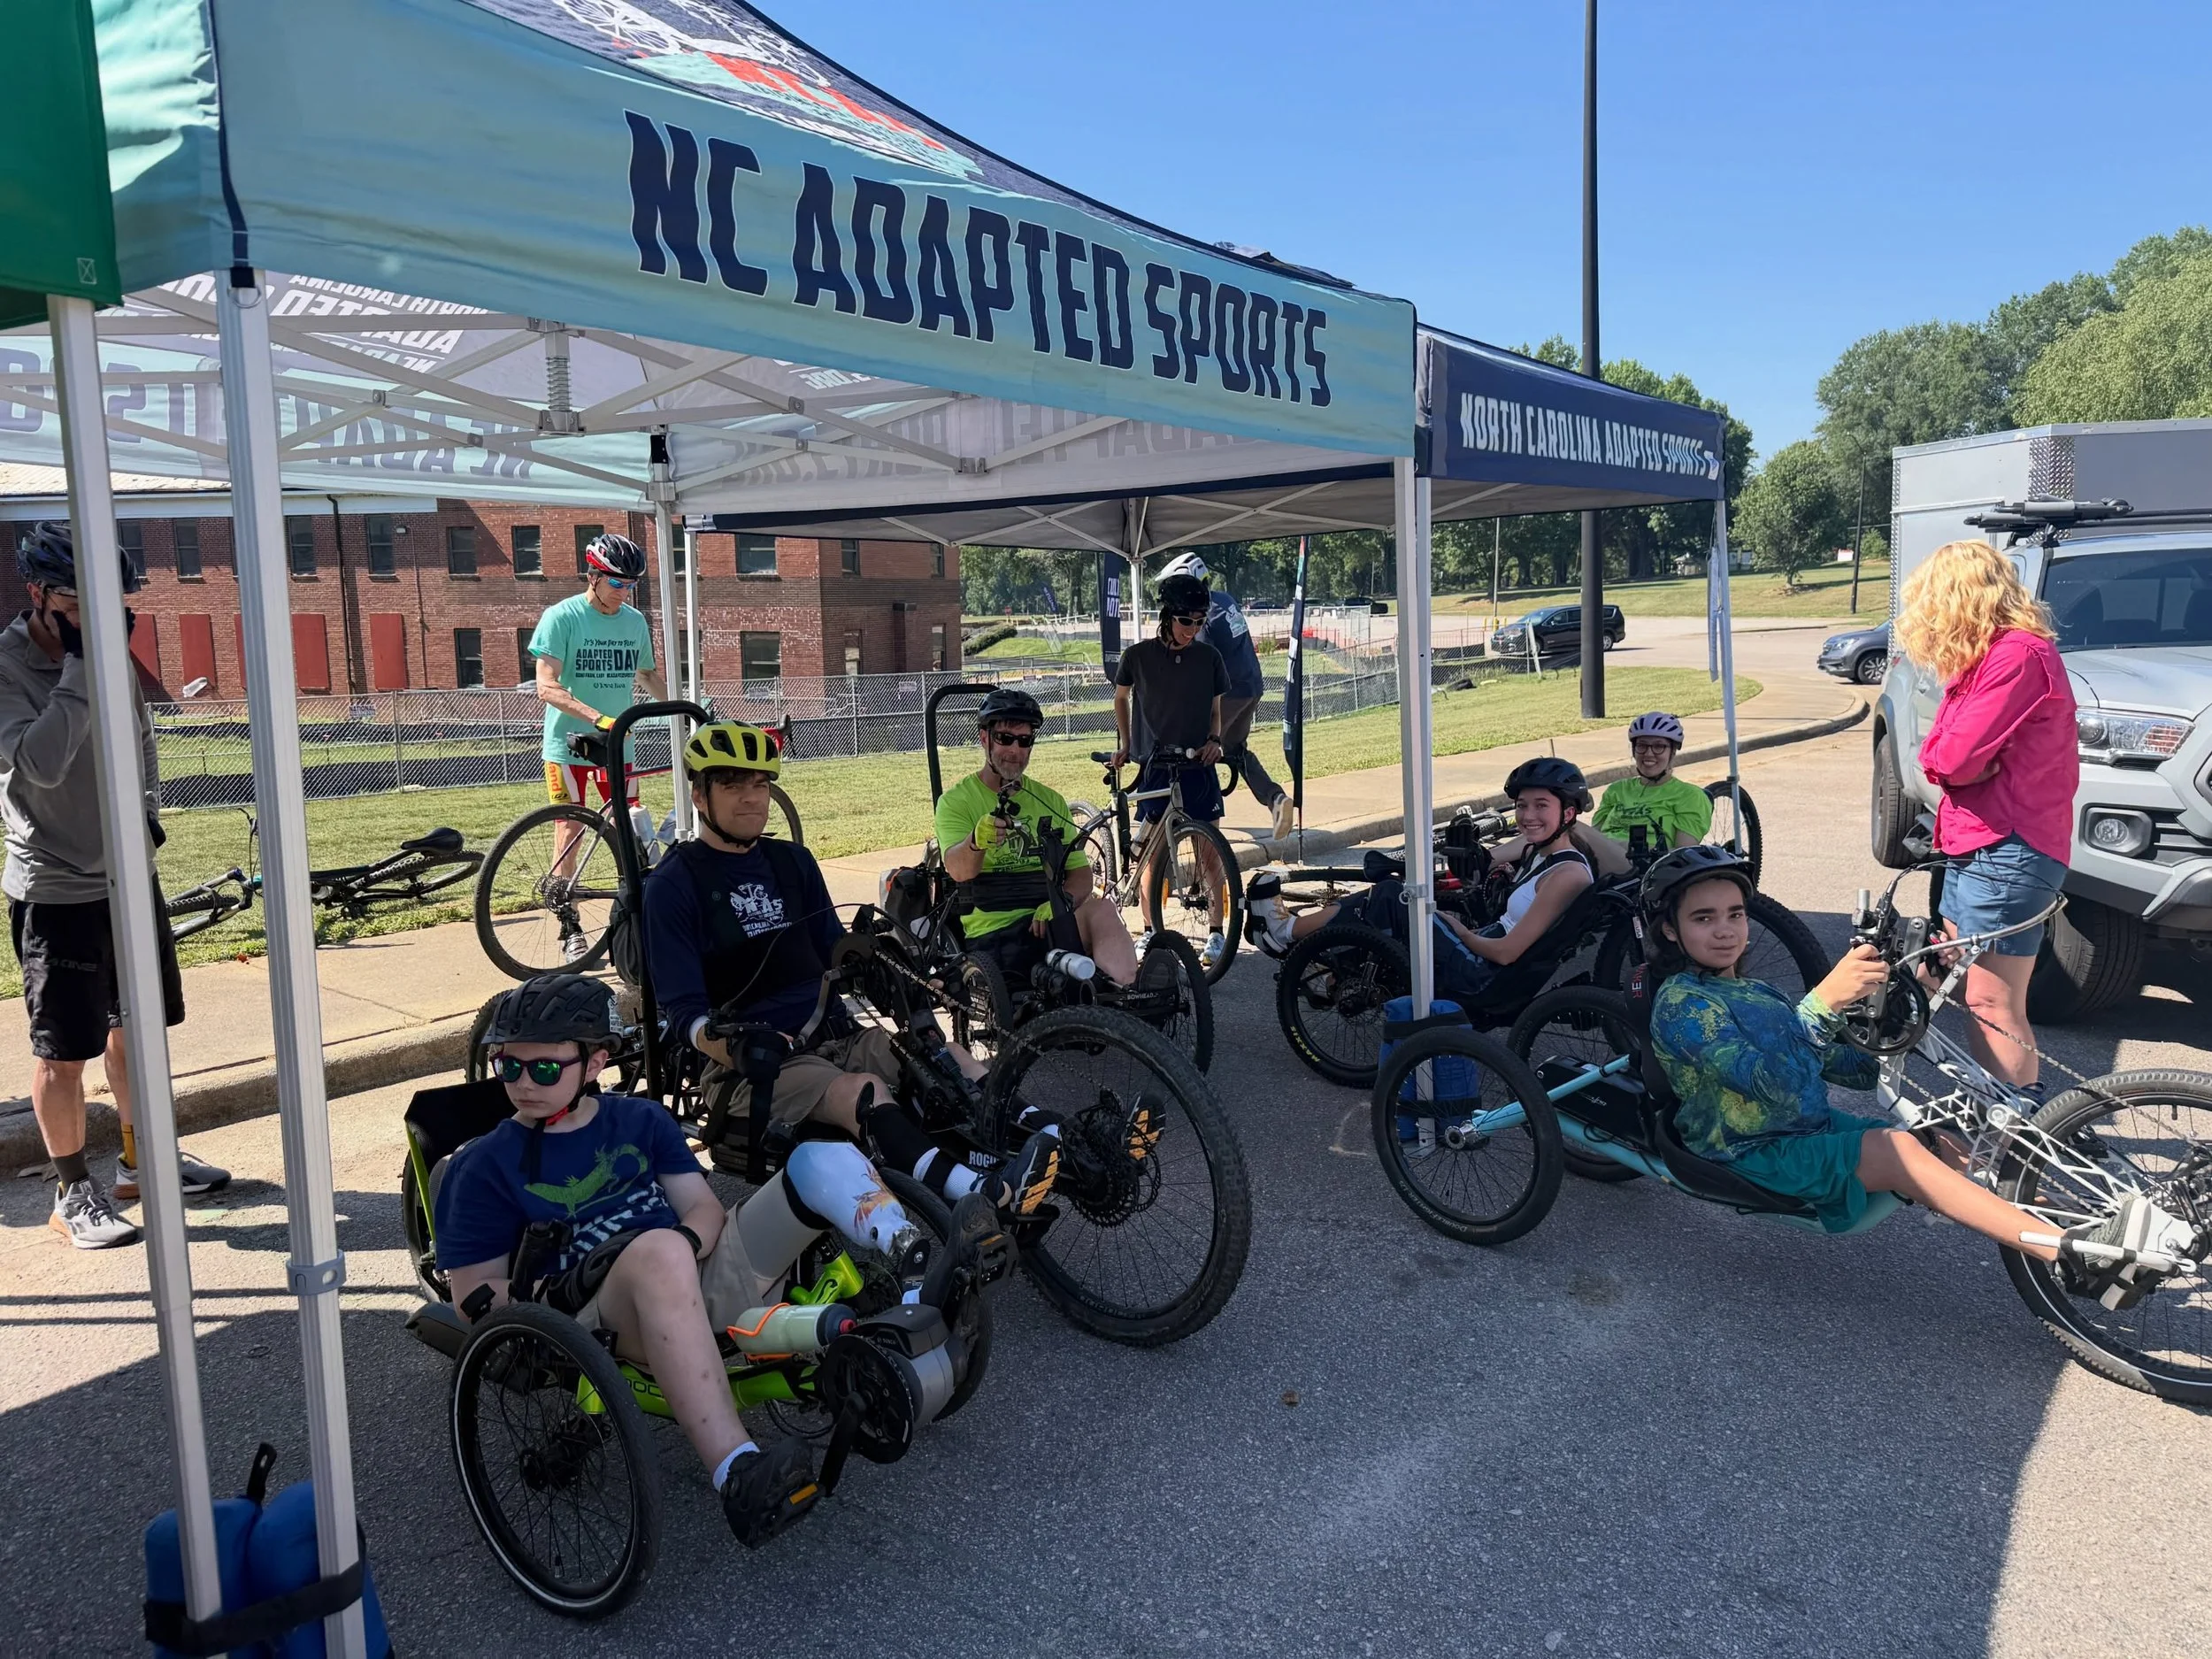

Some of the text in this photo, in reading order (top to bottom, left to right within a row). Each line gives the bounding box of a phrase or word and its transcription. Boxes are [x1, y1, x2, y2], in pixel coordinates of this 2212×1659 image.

[624, 109, 1332, 408] NC ADAPTED SPORTS
[1461, 392, 1522, 454] NORTH
[1526, 405, 1602, 464] CAROLINA
[1605, 420, 1663, 472] ADAPTED
[1663, 433, 1706, 476] SPORTS
[575, 659, 612, 671] SPORTS
[576, 649, 612, 659] ADAPTED
[613, 649, 640, 671] DAY
[1290, 1025, 1321, 1062] MAXXIS
[969, 1150, 1000, 1168] ROGU
